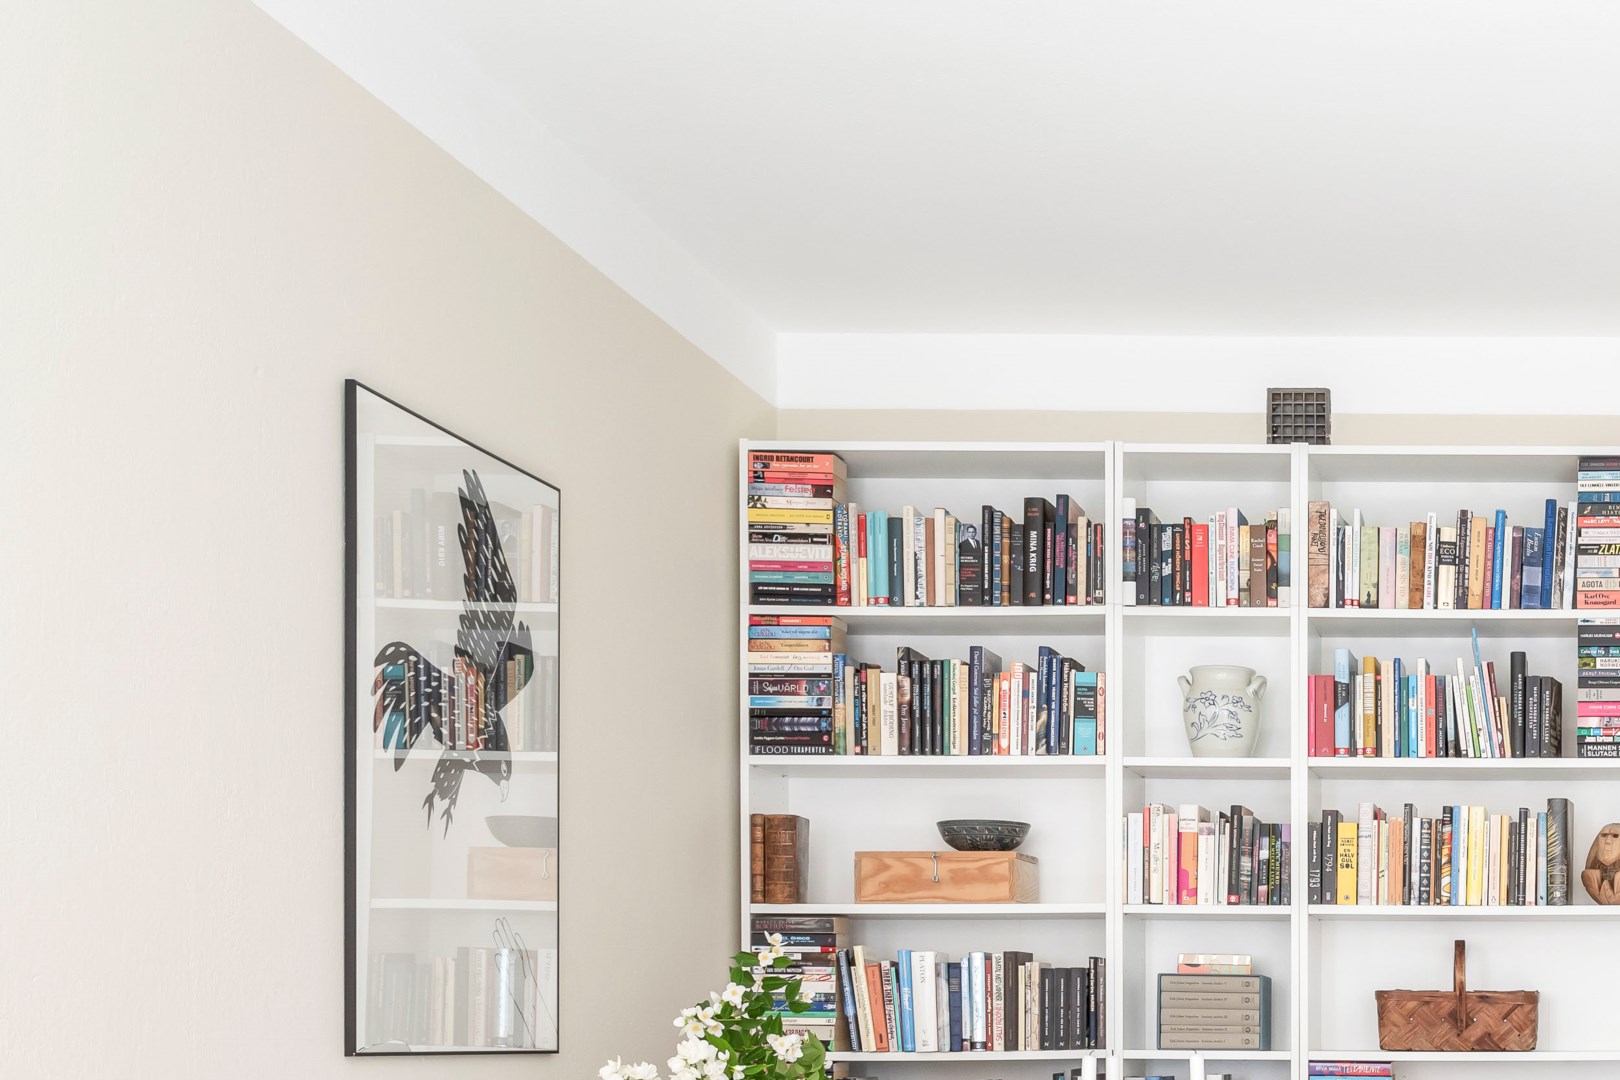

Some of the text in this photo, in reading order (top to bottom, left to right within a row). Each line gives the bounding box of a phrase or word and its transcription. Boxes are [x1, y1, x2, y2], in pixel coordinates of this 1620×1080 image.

[1029, 530, 1037, 573] MINA KRIG
[1526, 538, 1534, 557] Berlin
[1325, 853, 1334, 872] 1794
[1309, 869, 1320, 888] 1793
